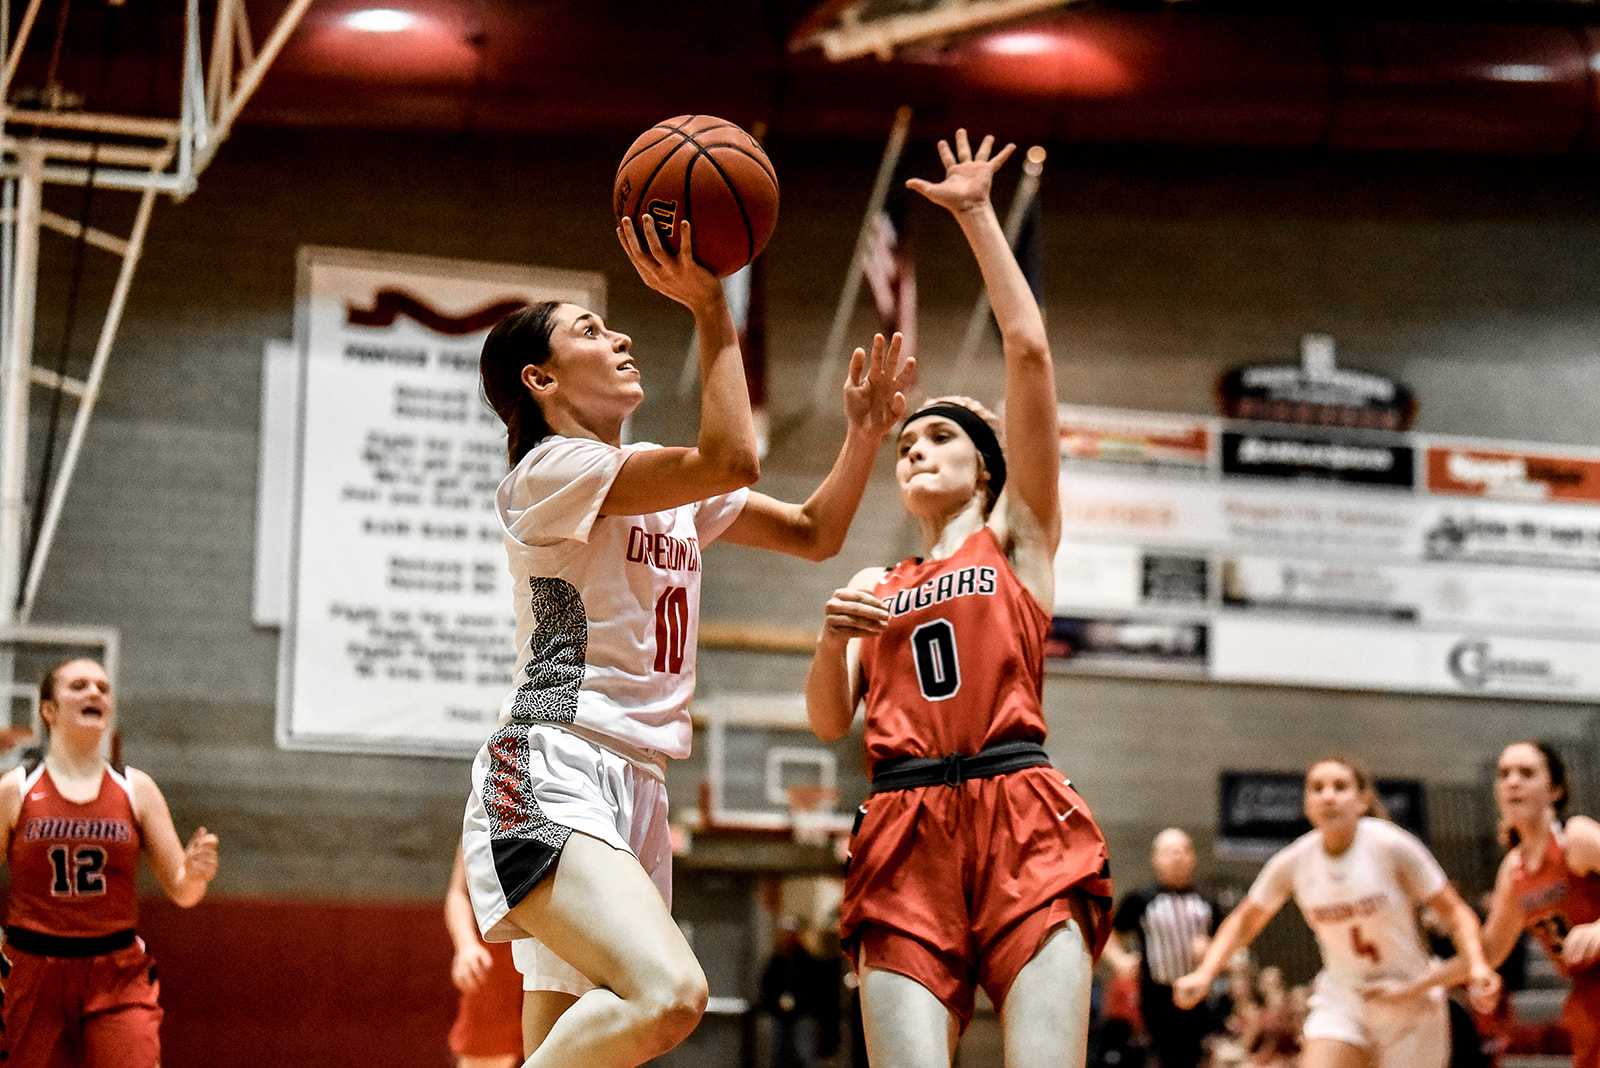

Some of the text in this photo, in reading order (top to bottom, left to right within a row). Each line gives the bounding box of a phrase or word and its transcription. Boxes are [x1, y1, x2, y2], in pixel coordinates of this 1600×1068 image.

[882, 566, 997, 617] UGARS
[654, 586, 690, 675] 10
[911, 618, 962, 702] 0
[23, 815, 131, 843] COUGARS
[47, 844, 107, 898] 12
[1349, 923, 1381, 965] 4
